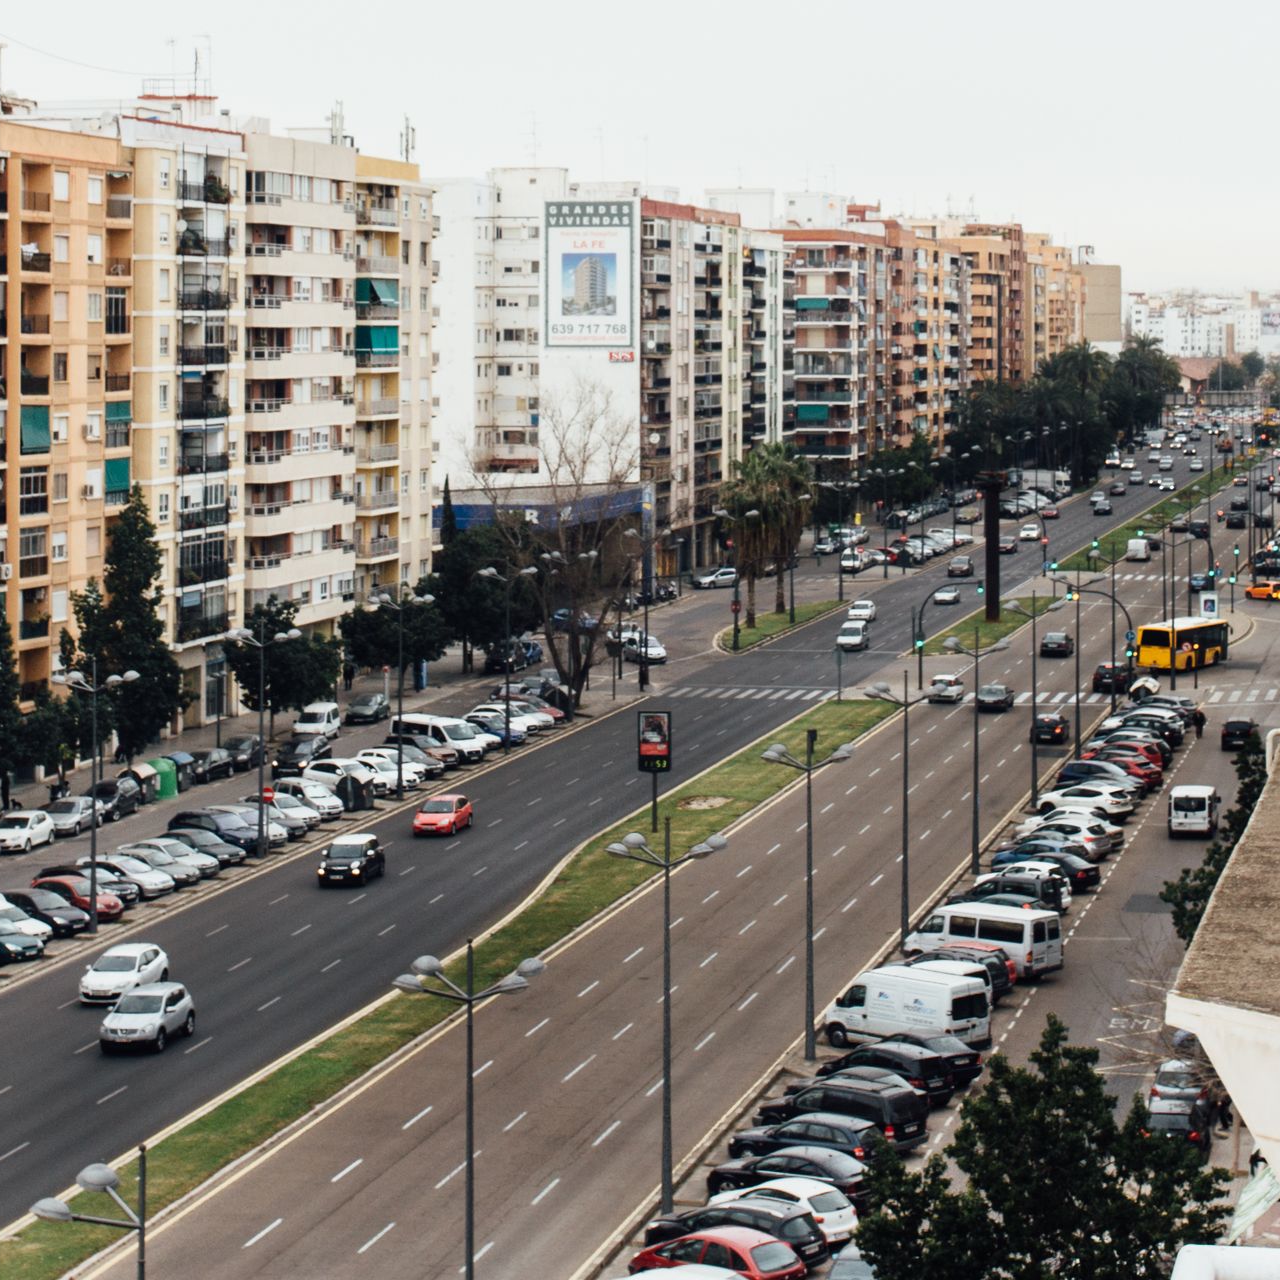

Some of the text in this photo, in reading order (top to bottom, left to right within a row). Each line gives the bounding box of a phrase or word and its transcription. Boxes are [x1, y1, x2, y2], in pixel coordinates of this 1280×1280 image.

[548, 205, 630, 214] GRANDES
[548, 216, 630, 225] VIVIENDAS
[573, 240, 606, 249] LA FE
[551, 323, 627, 334] 639 717 768
